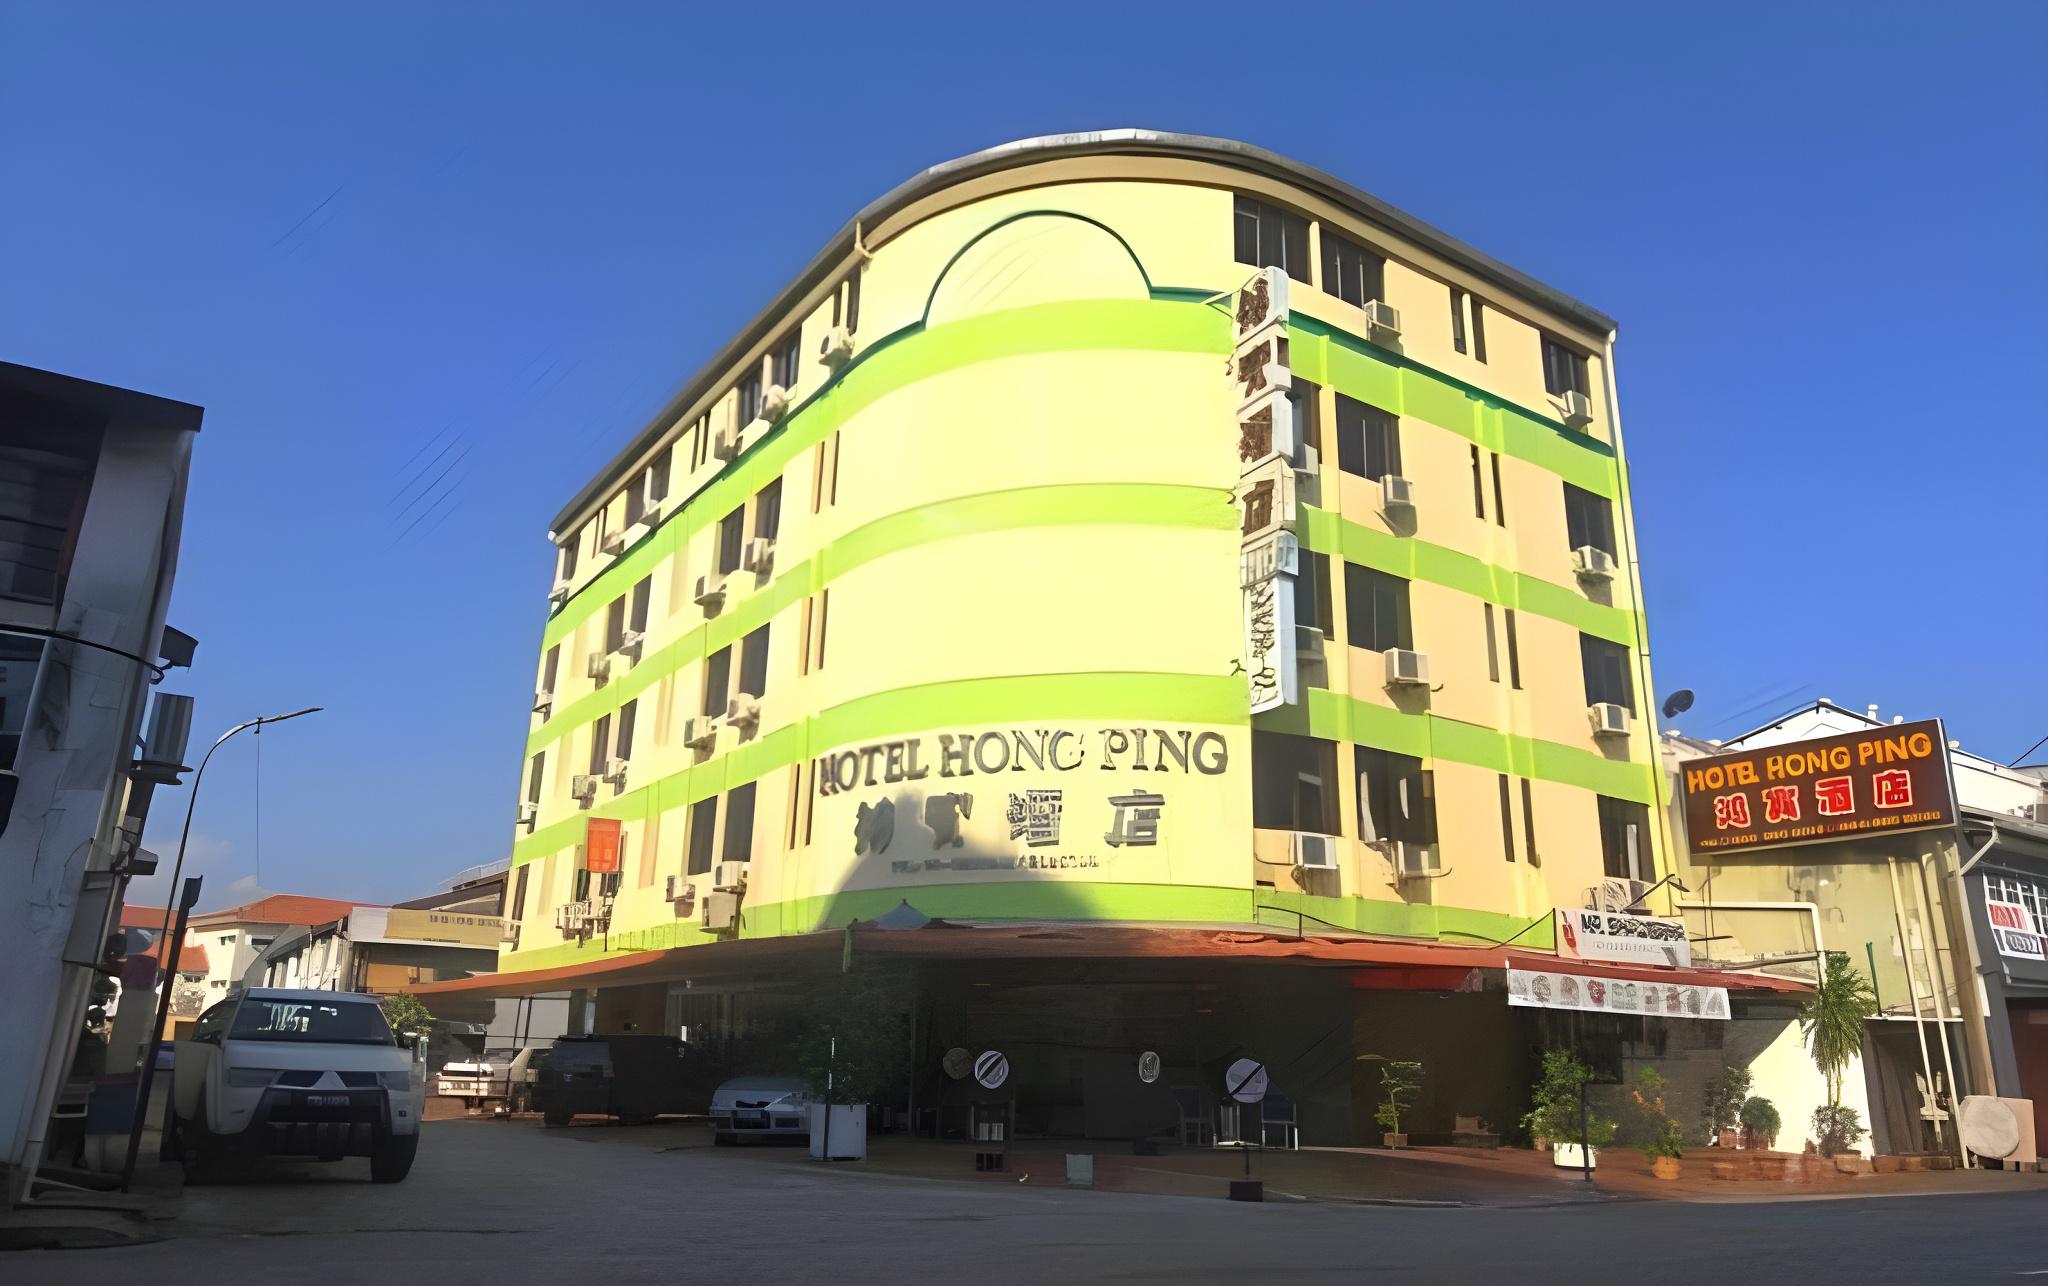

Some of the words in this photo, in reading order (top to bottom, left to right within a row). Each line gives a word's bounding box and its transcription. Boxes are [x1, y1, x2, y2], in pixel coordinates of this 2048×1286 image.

[819, 738, 930, 796] HOTEL
[937, 728, 1085, 778] HONG
[1098, 727, 1229, 776] PING
[1686, 761, 1760, 795] HOTEL
[1765, 746, 1852, 781] HONG
